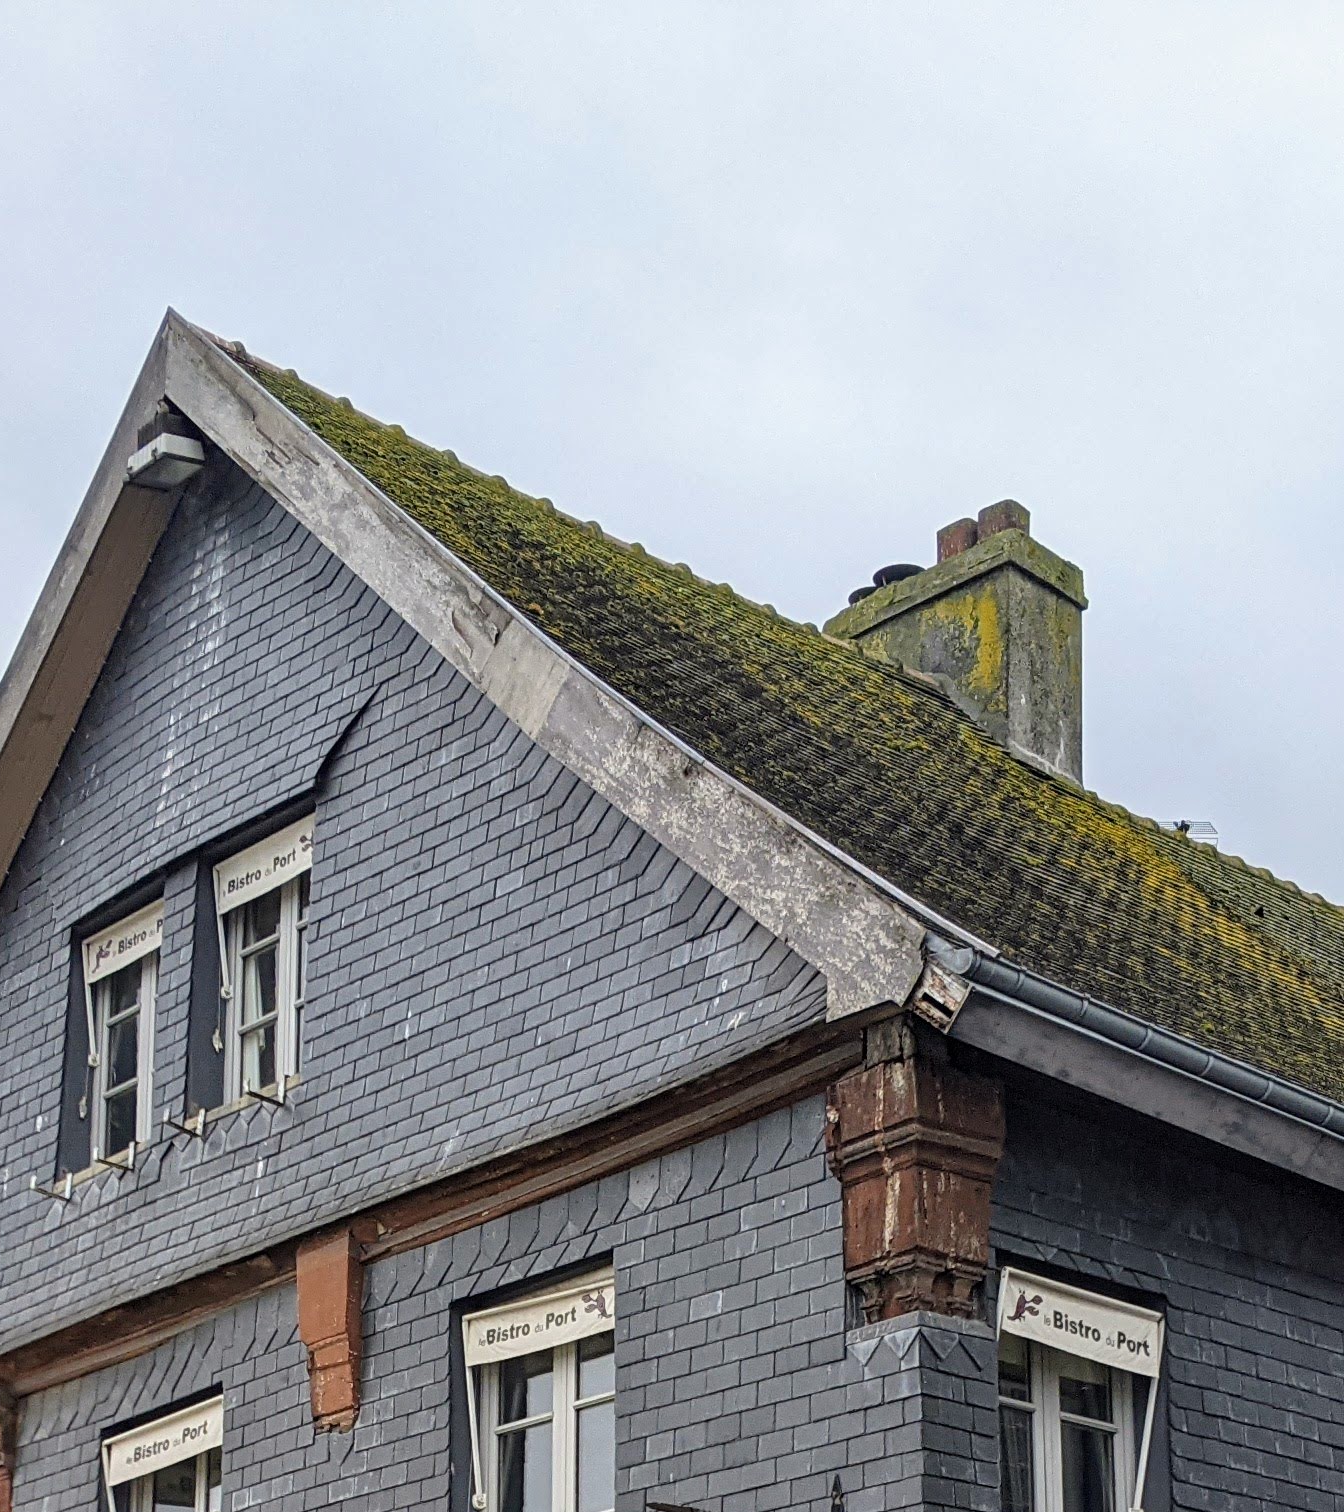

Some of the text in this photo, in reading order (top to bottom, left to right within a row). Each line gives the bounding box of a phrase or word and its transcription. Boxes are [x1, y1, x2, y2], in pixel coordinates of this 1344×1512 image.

[228, 869, 262, 894] Bistro
[273, 848, 297, 873] Port
[118, 930, 147, 955] Bistro
[486, 1322, 531, 1345] Bistro
[534, 1322, 544, 1334] du
[546, 1306, 577, 1330] Port
[1044, 1310, 1150, 1357] le Bistro du Port
[133, 1438, 170, 1463] Bistro
[182, 1420, 208, 1444] Port
